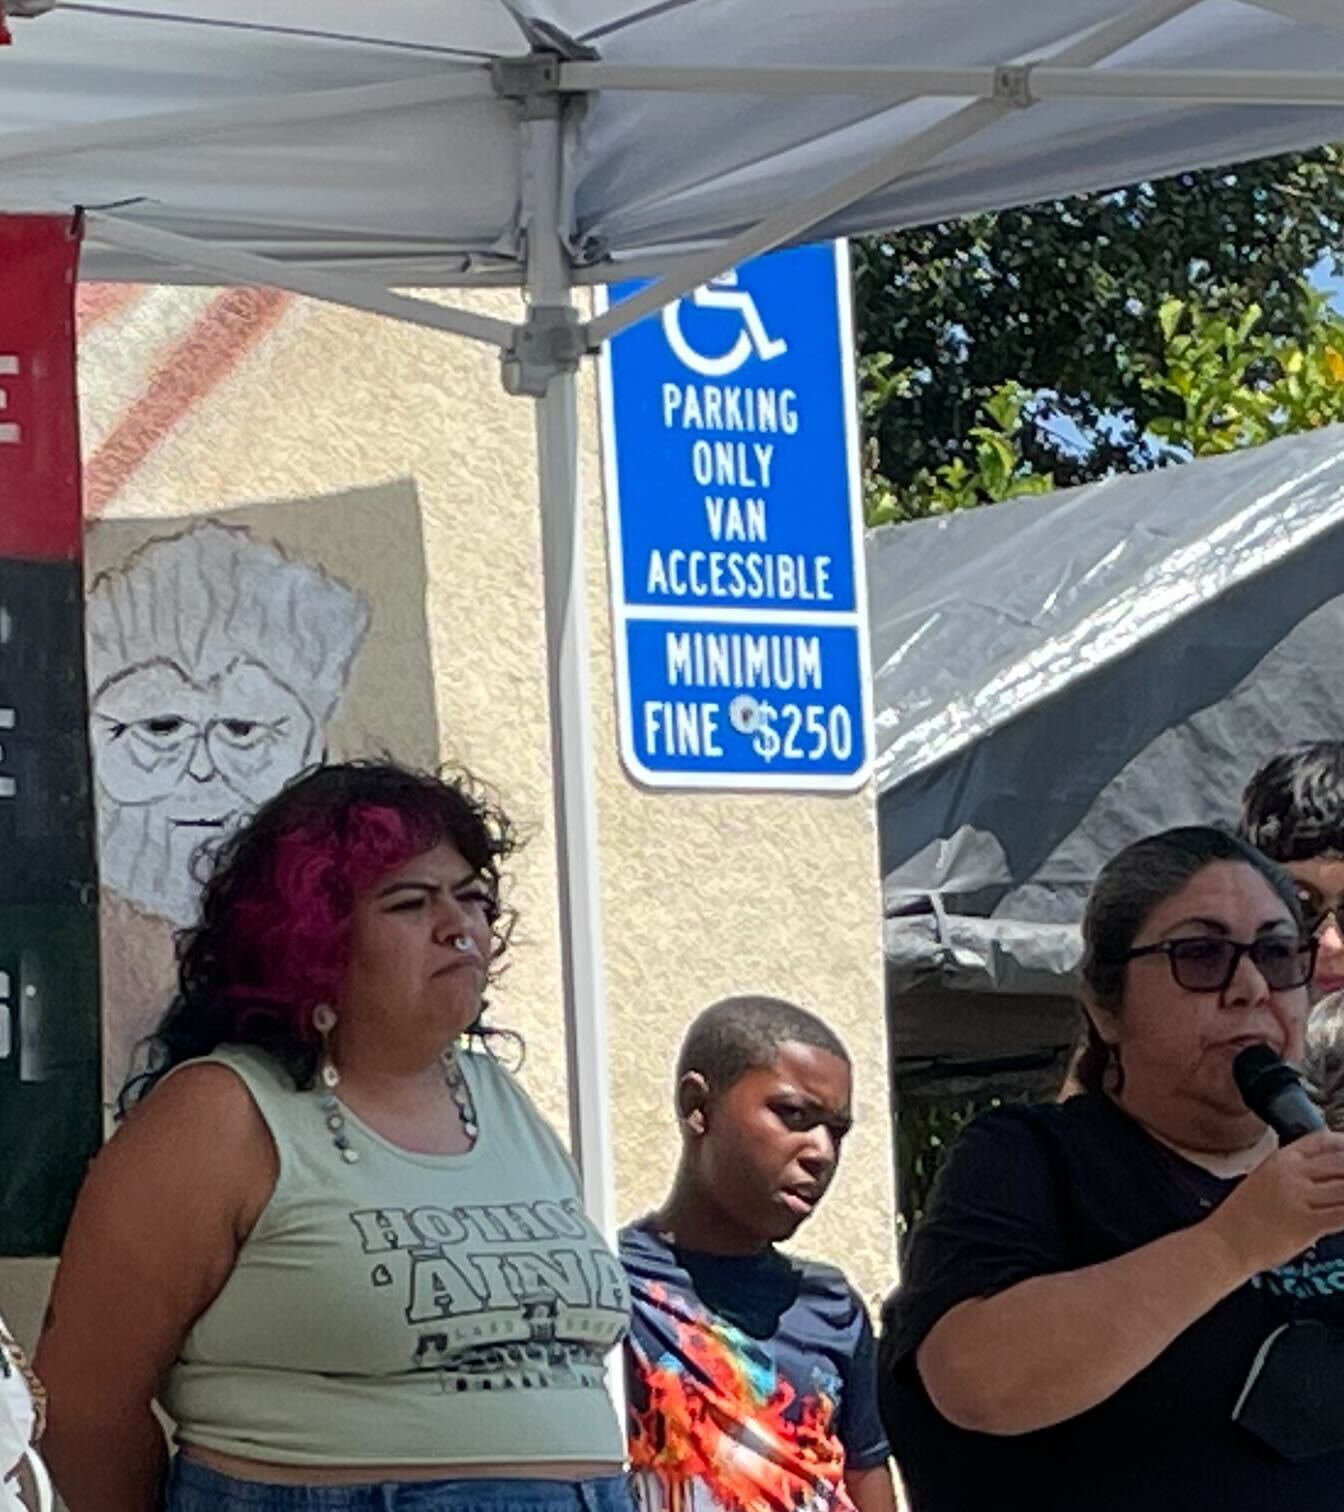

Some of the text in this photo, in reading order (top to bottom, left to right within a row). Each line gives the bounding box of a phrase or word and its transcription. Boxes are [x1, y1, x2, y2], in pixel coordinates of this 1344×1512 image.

[662, 382, 799, 435] PARKING
[692, 439, 774, 488] ONLY
[704, 495, 768, 543] VAN
[647, 548, 834, 601] ACCESSIBLE
[665, 632, 823, 690] MINIMUM
[644, 700, 853, 763] FINE $250
